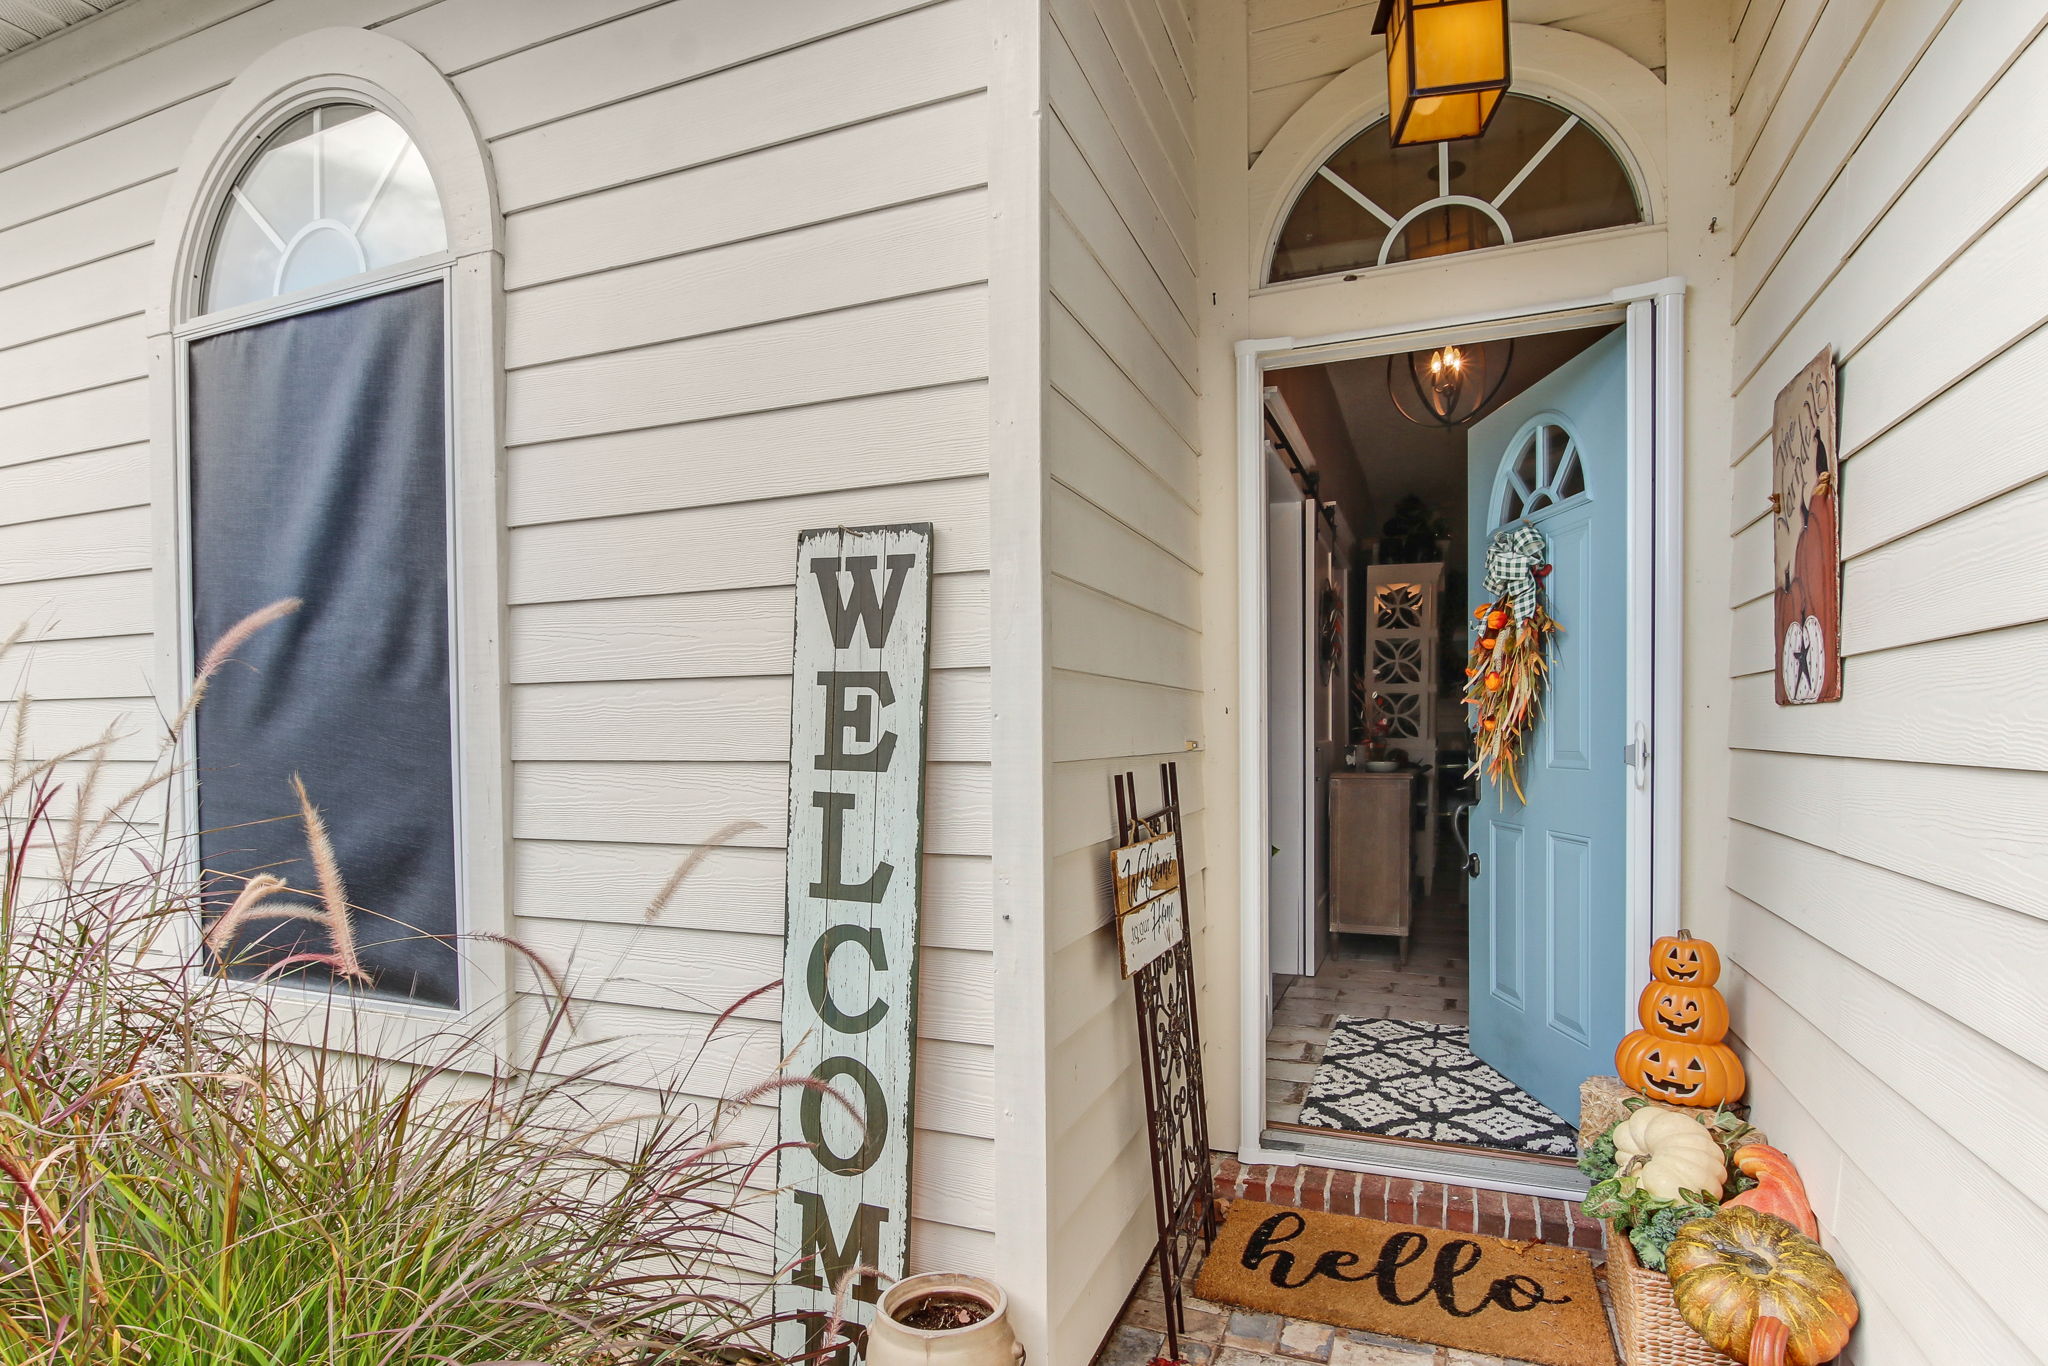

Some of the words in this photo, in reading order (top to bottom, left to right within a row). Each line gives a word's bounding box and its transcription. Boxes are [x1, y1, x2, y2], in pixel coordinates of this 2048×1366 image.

[1121, 842, 1173, 907] Welcome
[1150, 898, 1174, 941] Home
[1240, 1211, 1573, 1318] hello
